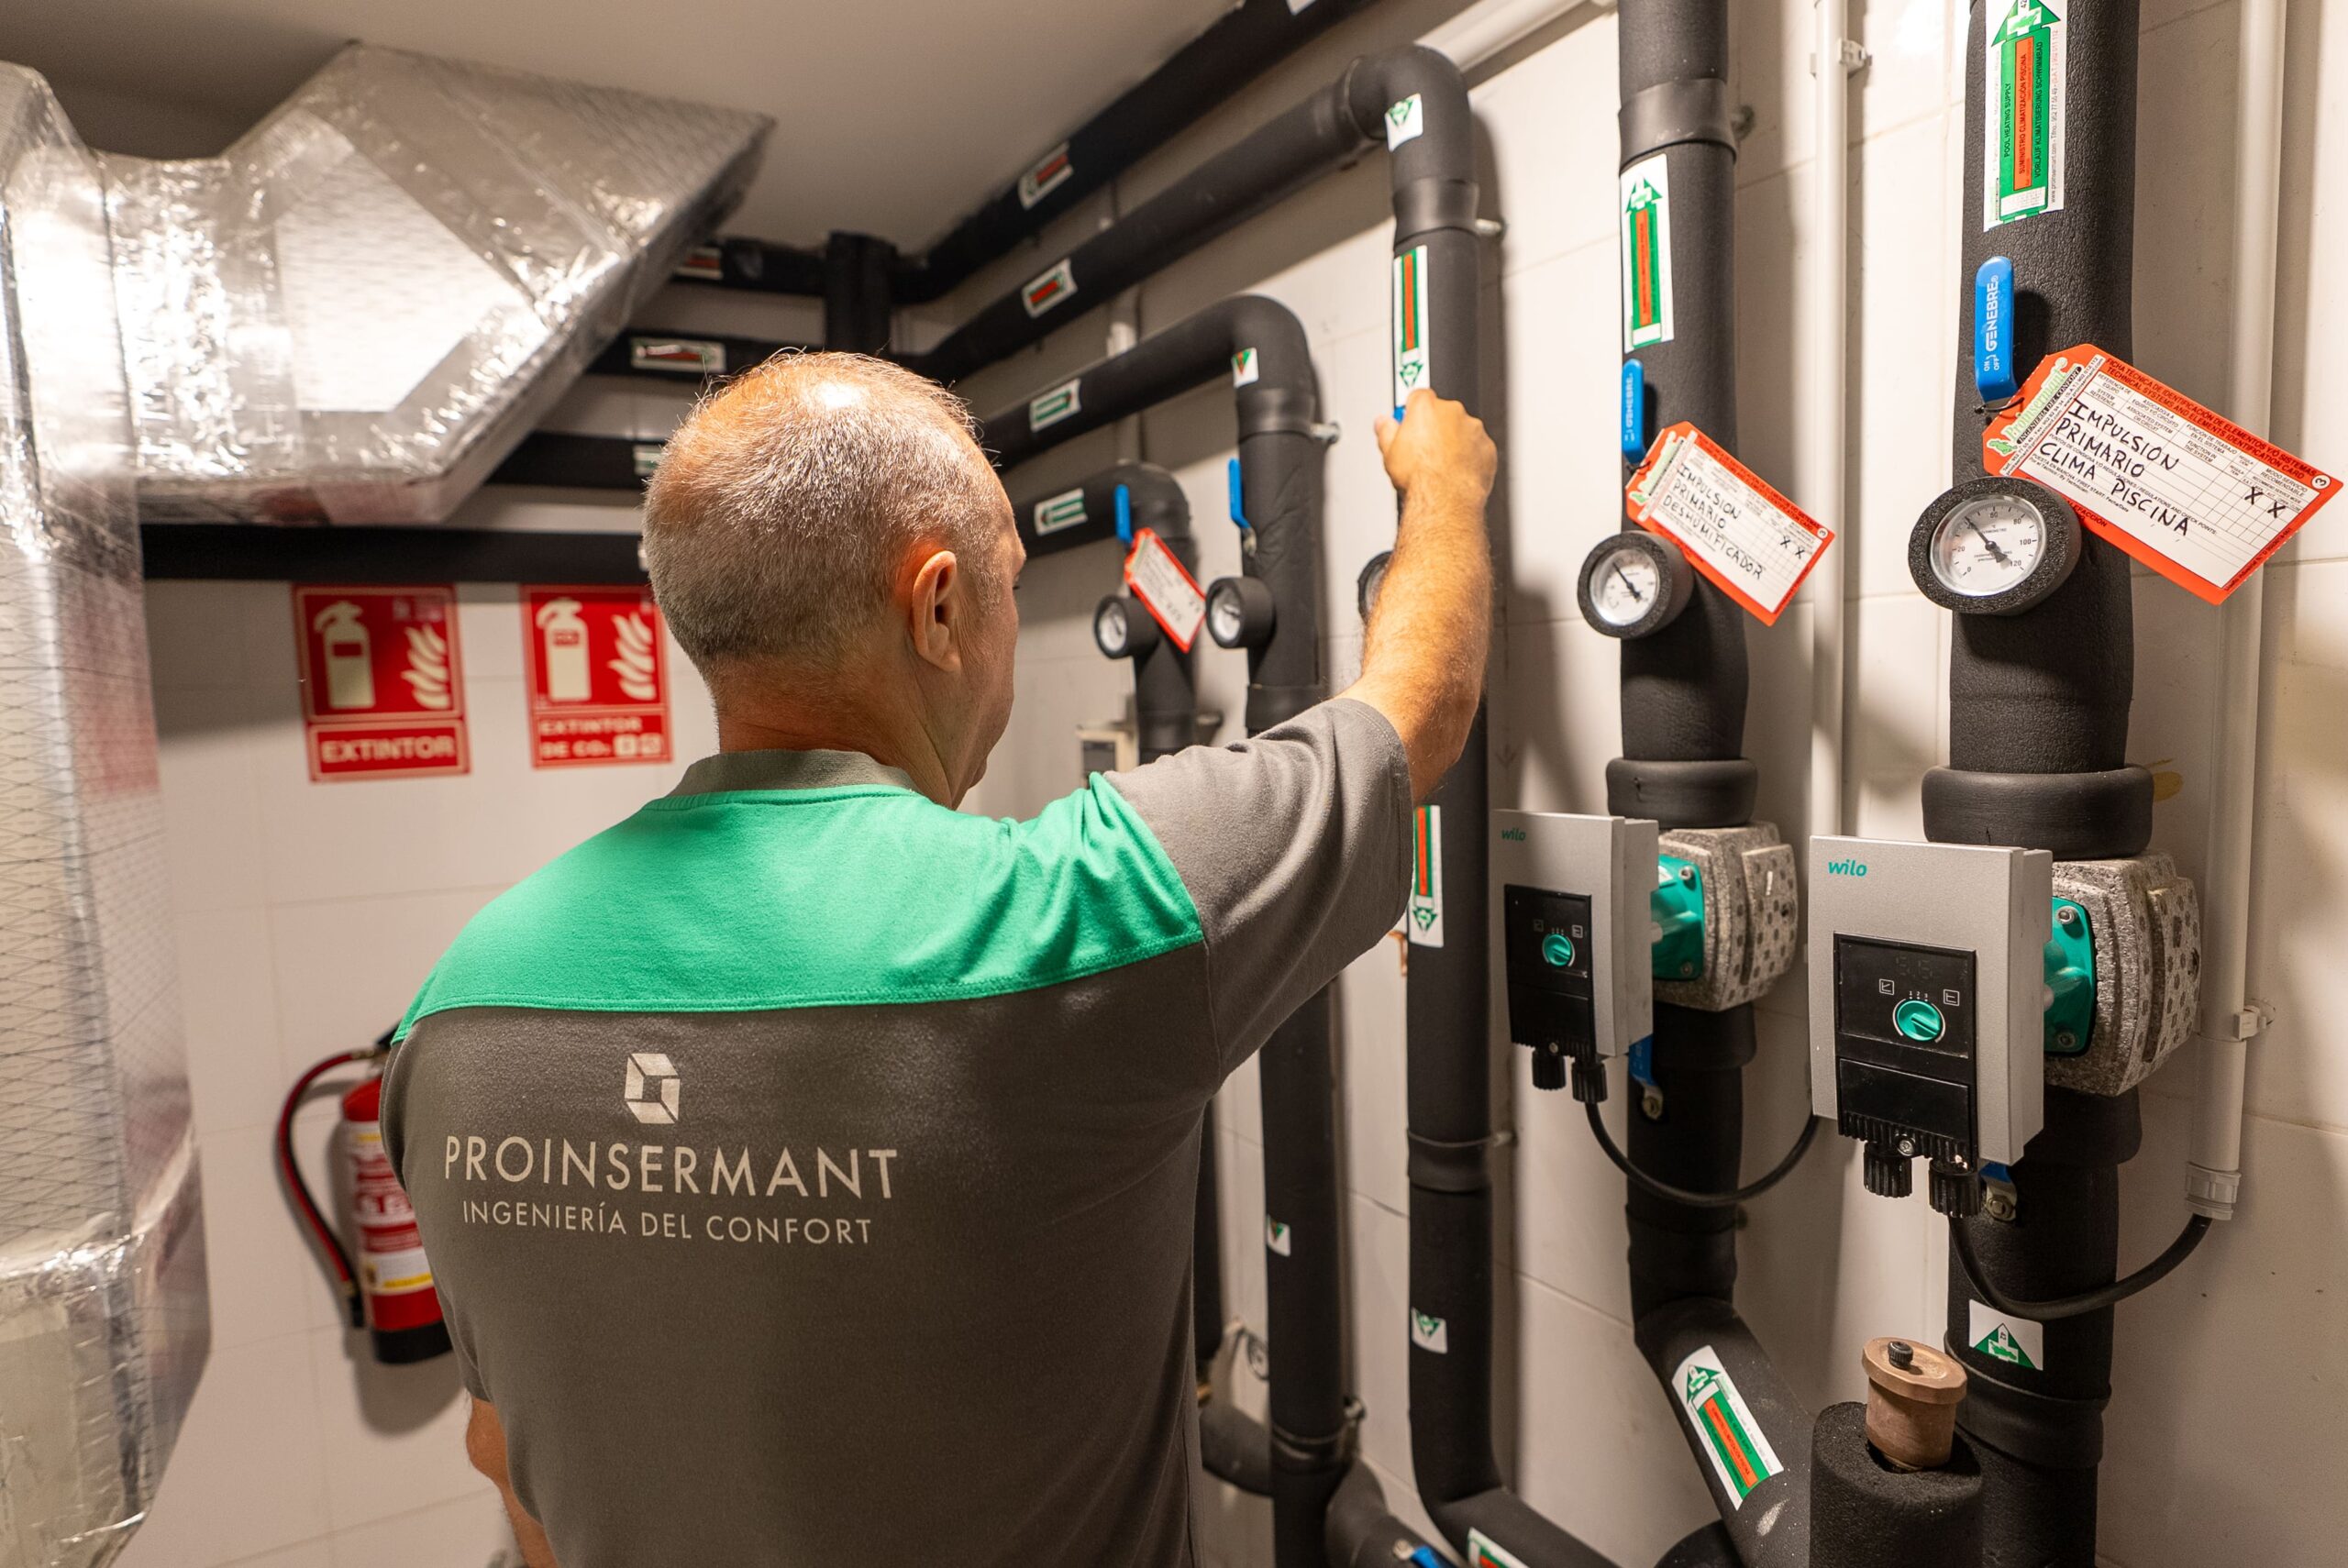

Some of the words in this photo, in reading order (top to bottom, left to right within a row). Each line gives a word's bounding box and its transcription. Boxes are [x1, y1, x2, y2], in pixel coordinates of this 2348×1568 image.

[2106, 359, 2126, 371] FICHA
[2124, 368, 2153, 387] TÉCNICA
[2152, 384, 2162, 392] DE
[2161, 388, 2215, 421] IDENTIFICACIÓN
[2212, 417, 2223, 426] DE
[2223, 423, 2266, 450] ELEMENTOS
[2277, 452, 2317, 478] SISTEMAS
[2106, 367, 2142, 390] TECHNICAL
[2142, 387, 2175, 408] SYSTEMS
[2172, 403, 2189, 416] AND
[2187, 413, 2226, 436] ELEMENTS
[2225, 432, 2283, 468] IDENTIFICATION
[2281, 463, 2305, 480] CARD
[2054, 416, 2144, 480] PRIMARIO
[1670, 478, 1728, 529] PRIMARIO
[2037, 438, 2099, 481] CLIMA
[2108, 477, 2193, 536] PISCINA
[2260, 470, 2304, 497] RECOMENDABLE
[2265, 468, 2282, 479] MODO
[2282, 476, 2307, 492] SERVICIO
[321, 736, 455, 763] EXTINTOR
[1501, 828, 1526, 842] wilo
[1828, 858, 1867, 877] wilo
[444, 1134, 897, 1199] PROINSERMANT
[462, 1200, 627, 1235] INGENIERÍA
[641, 1211, 692, 1239] DEL
[706, 1214, 872, 1244] CONFORT
